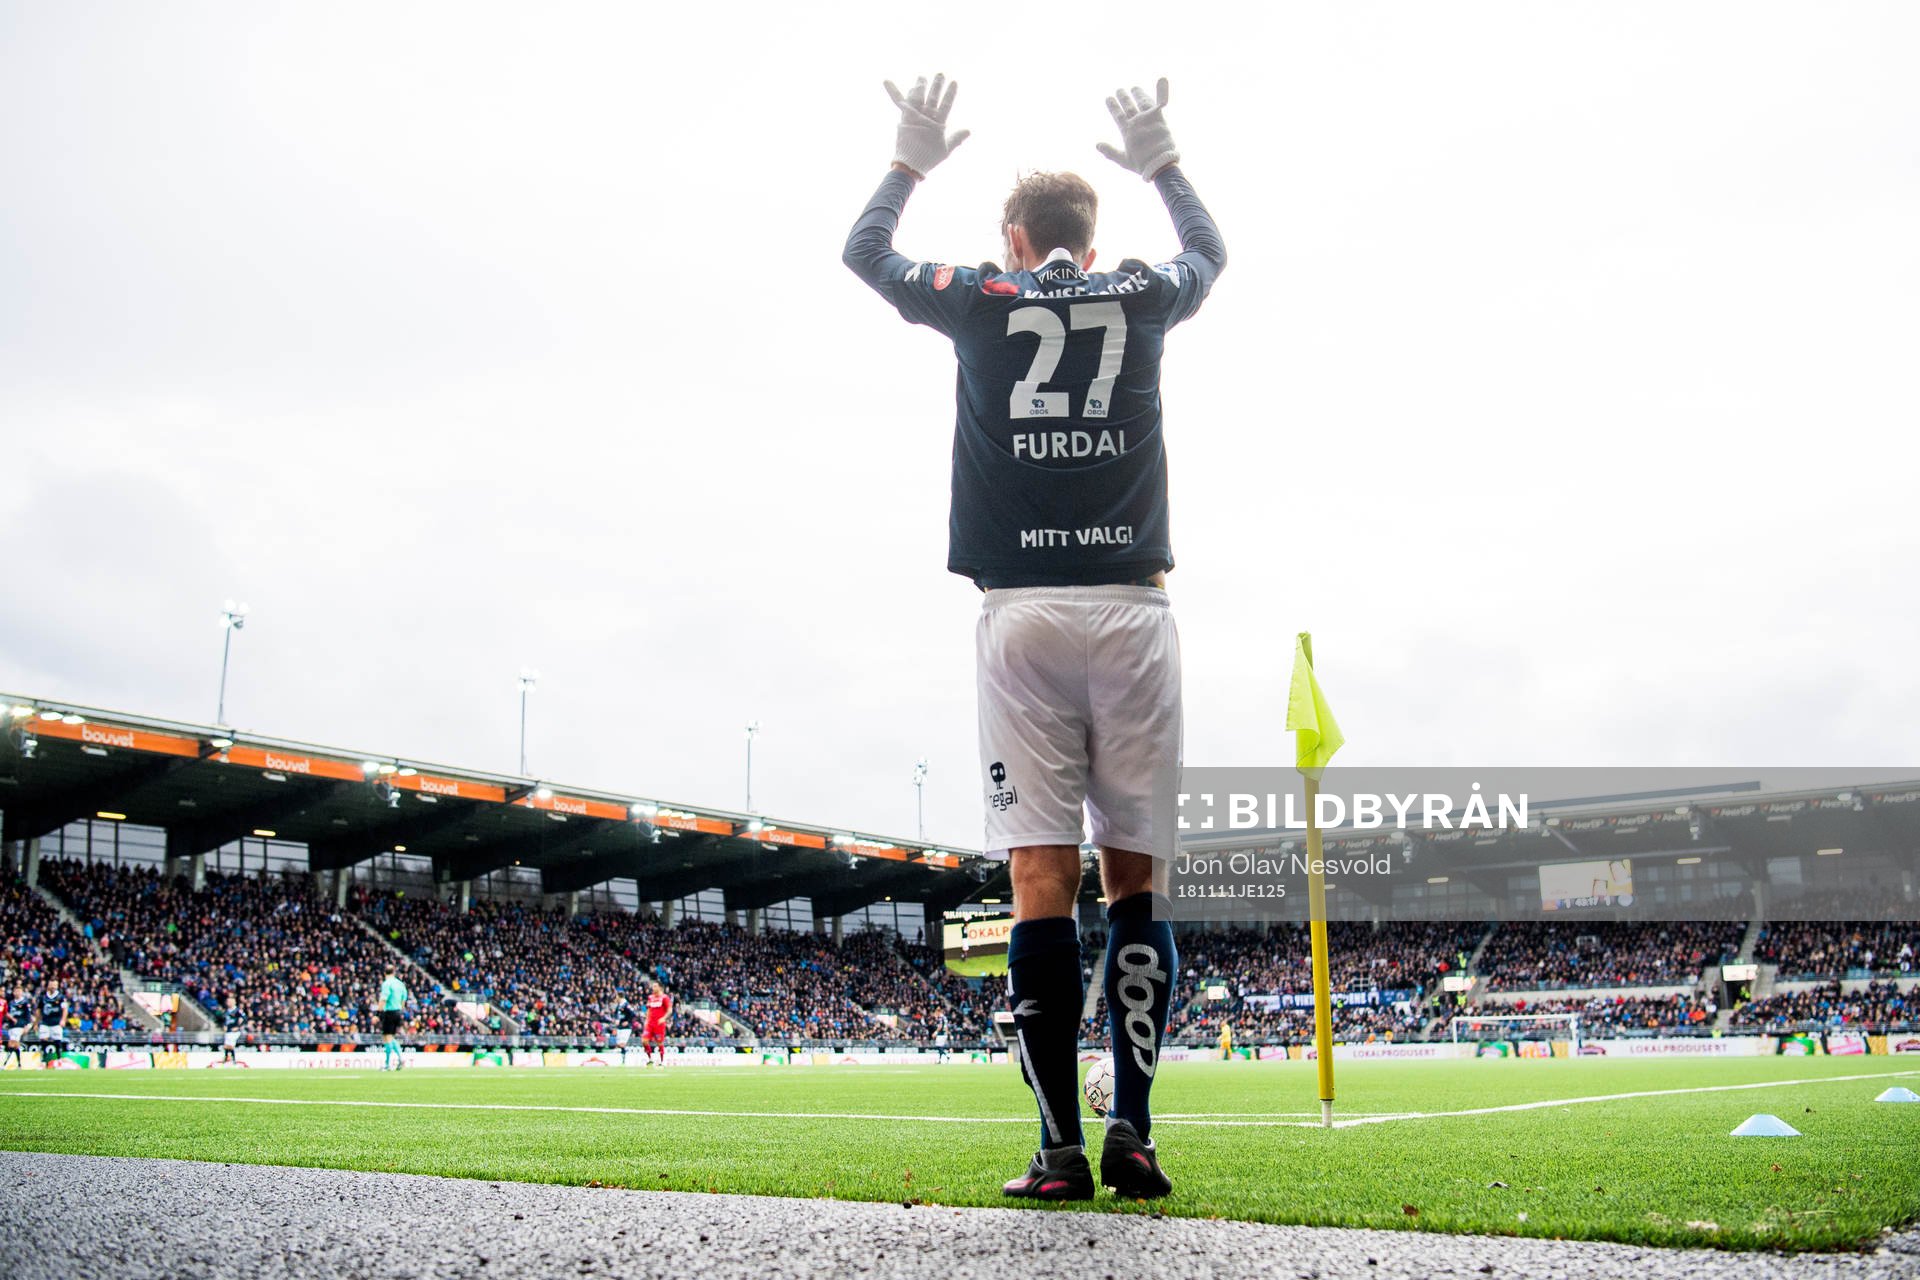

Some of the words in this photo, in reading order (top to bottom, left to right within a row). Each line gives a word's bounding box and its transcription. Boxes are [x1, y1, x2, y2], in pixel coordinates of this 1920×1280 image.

[1038, 267, 1089, 284] VIKING
[1007, 300, 1128, 419] 27
[1029, 408, 1049, 416] OBOS
[1087, 408, 1107, 416] OBOS
[1020, 529, 1071, 549] MITT
[1075, 526, 1134, 546] VALG!
[82, 724, 134, 748] bouvet
[265, 753, 310, 774] bouvet
[420, 776, 459, 796] bouvet
[553, 799, 588, 815] bouvet
[1352, 1048, 1436, 1059] LOKALPRODUSERT
[1630, 1043, 1729, 1054] LOKALPRODUSERT
